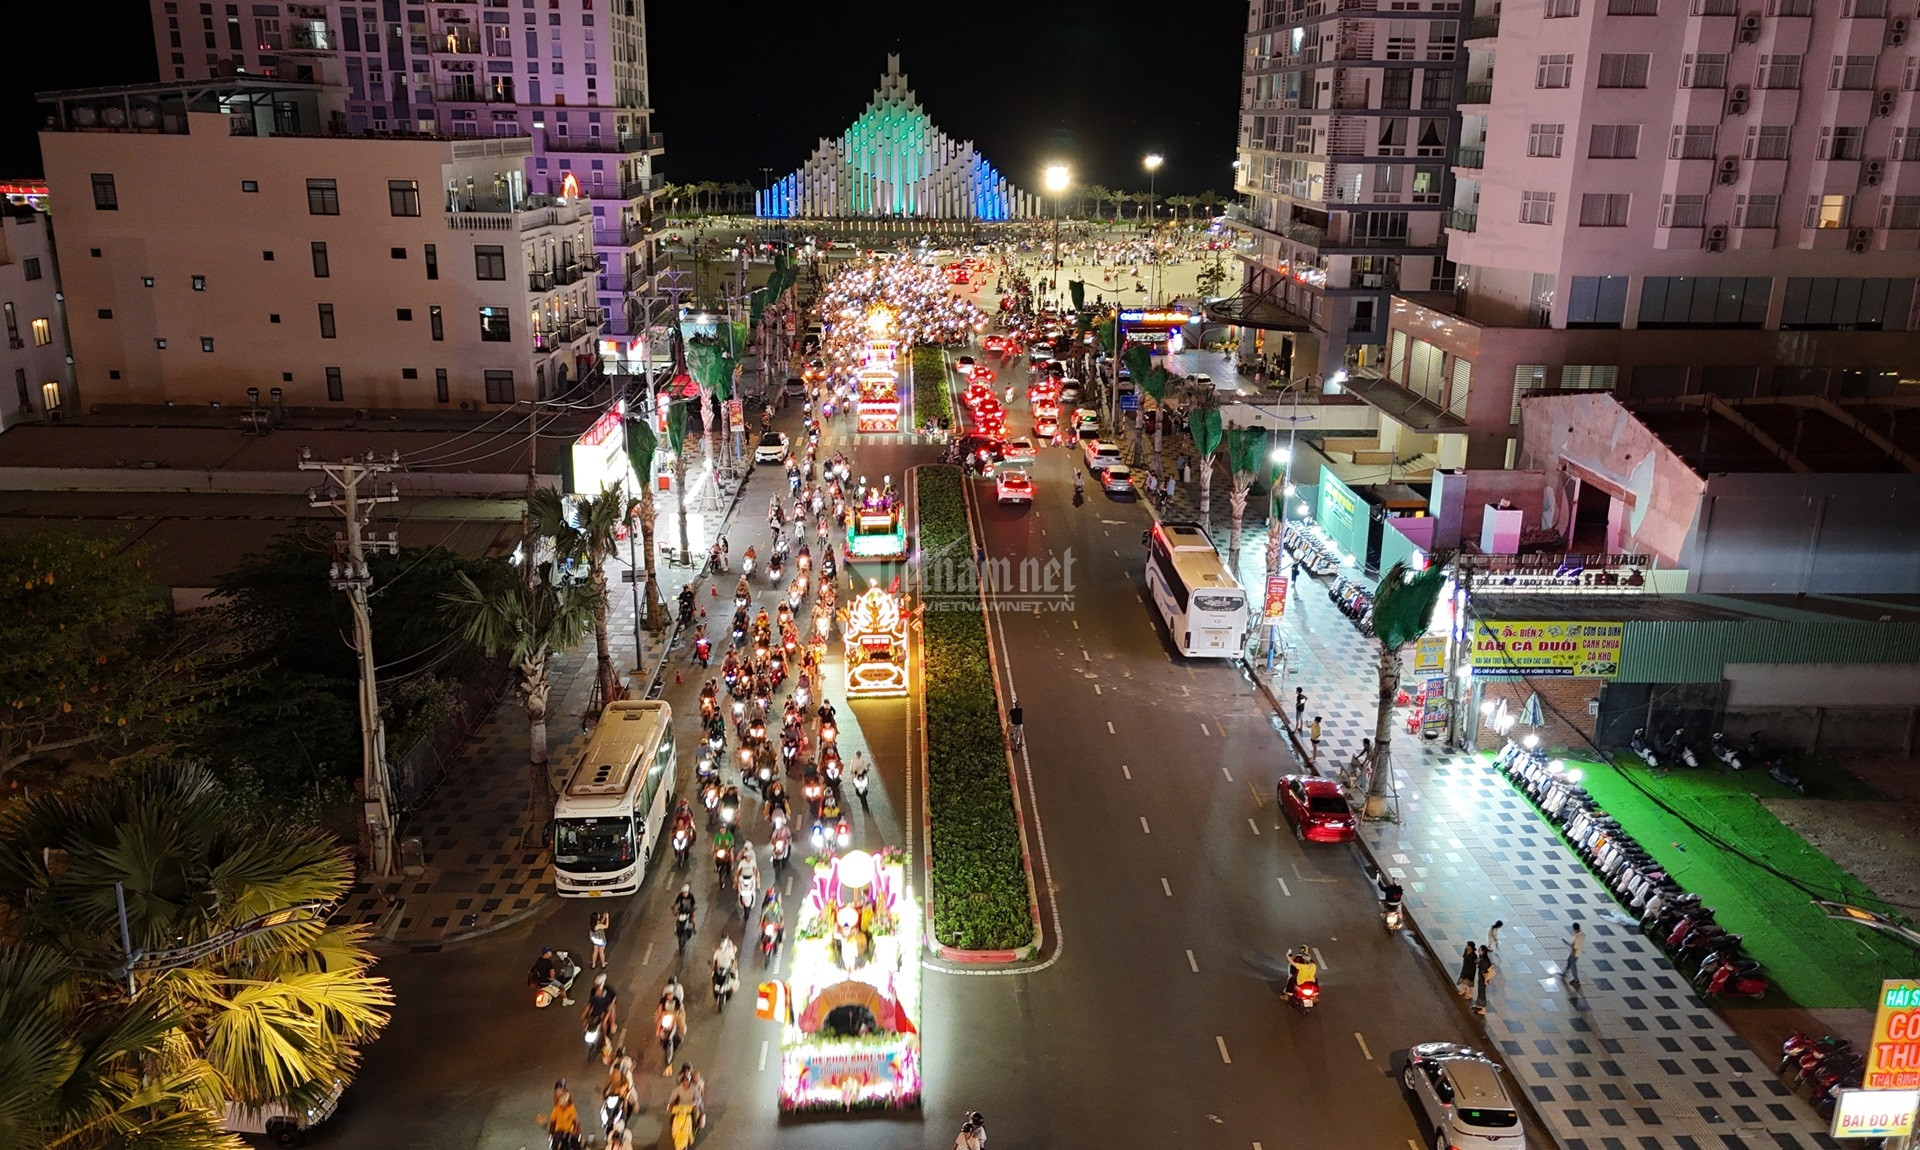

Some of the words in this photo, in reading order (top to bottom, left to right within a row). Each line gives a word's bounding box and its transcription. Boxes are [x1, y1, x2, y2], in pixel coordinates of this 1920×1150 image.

[1538, 628, 1544, 637] 2
[1598, 651, 1612, 661] KHO
[1886, 985, 1909, 1006] HẢI
[1910, 989, 1920, 1006] S
[1892, 1113, 1909, 1126] XE
